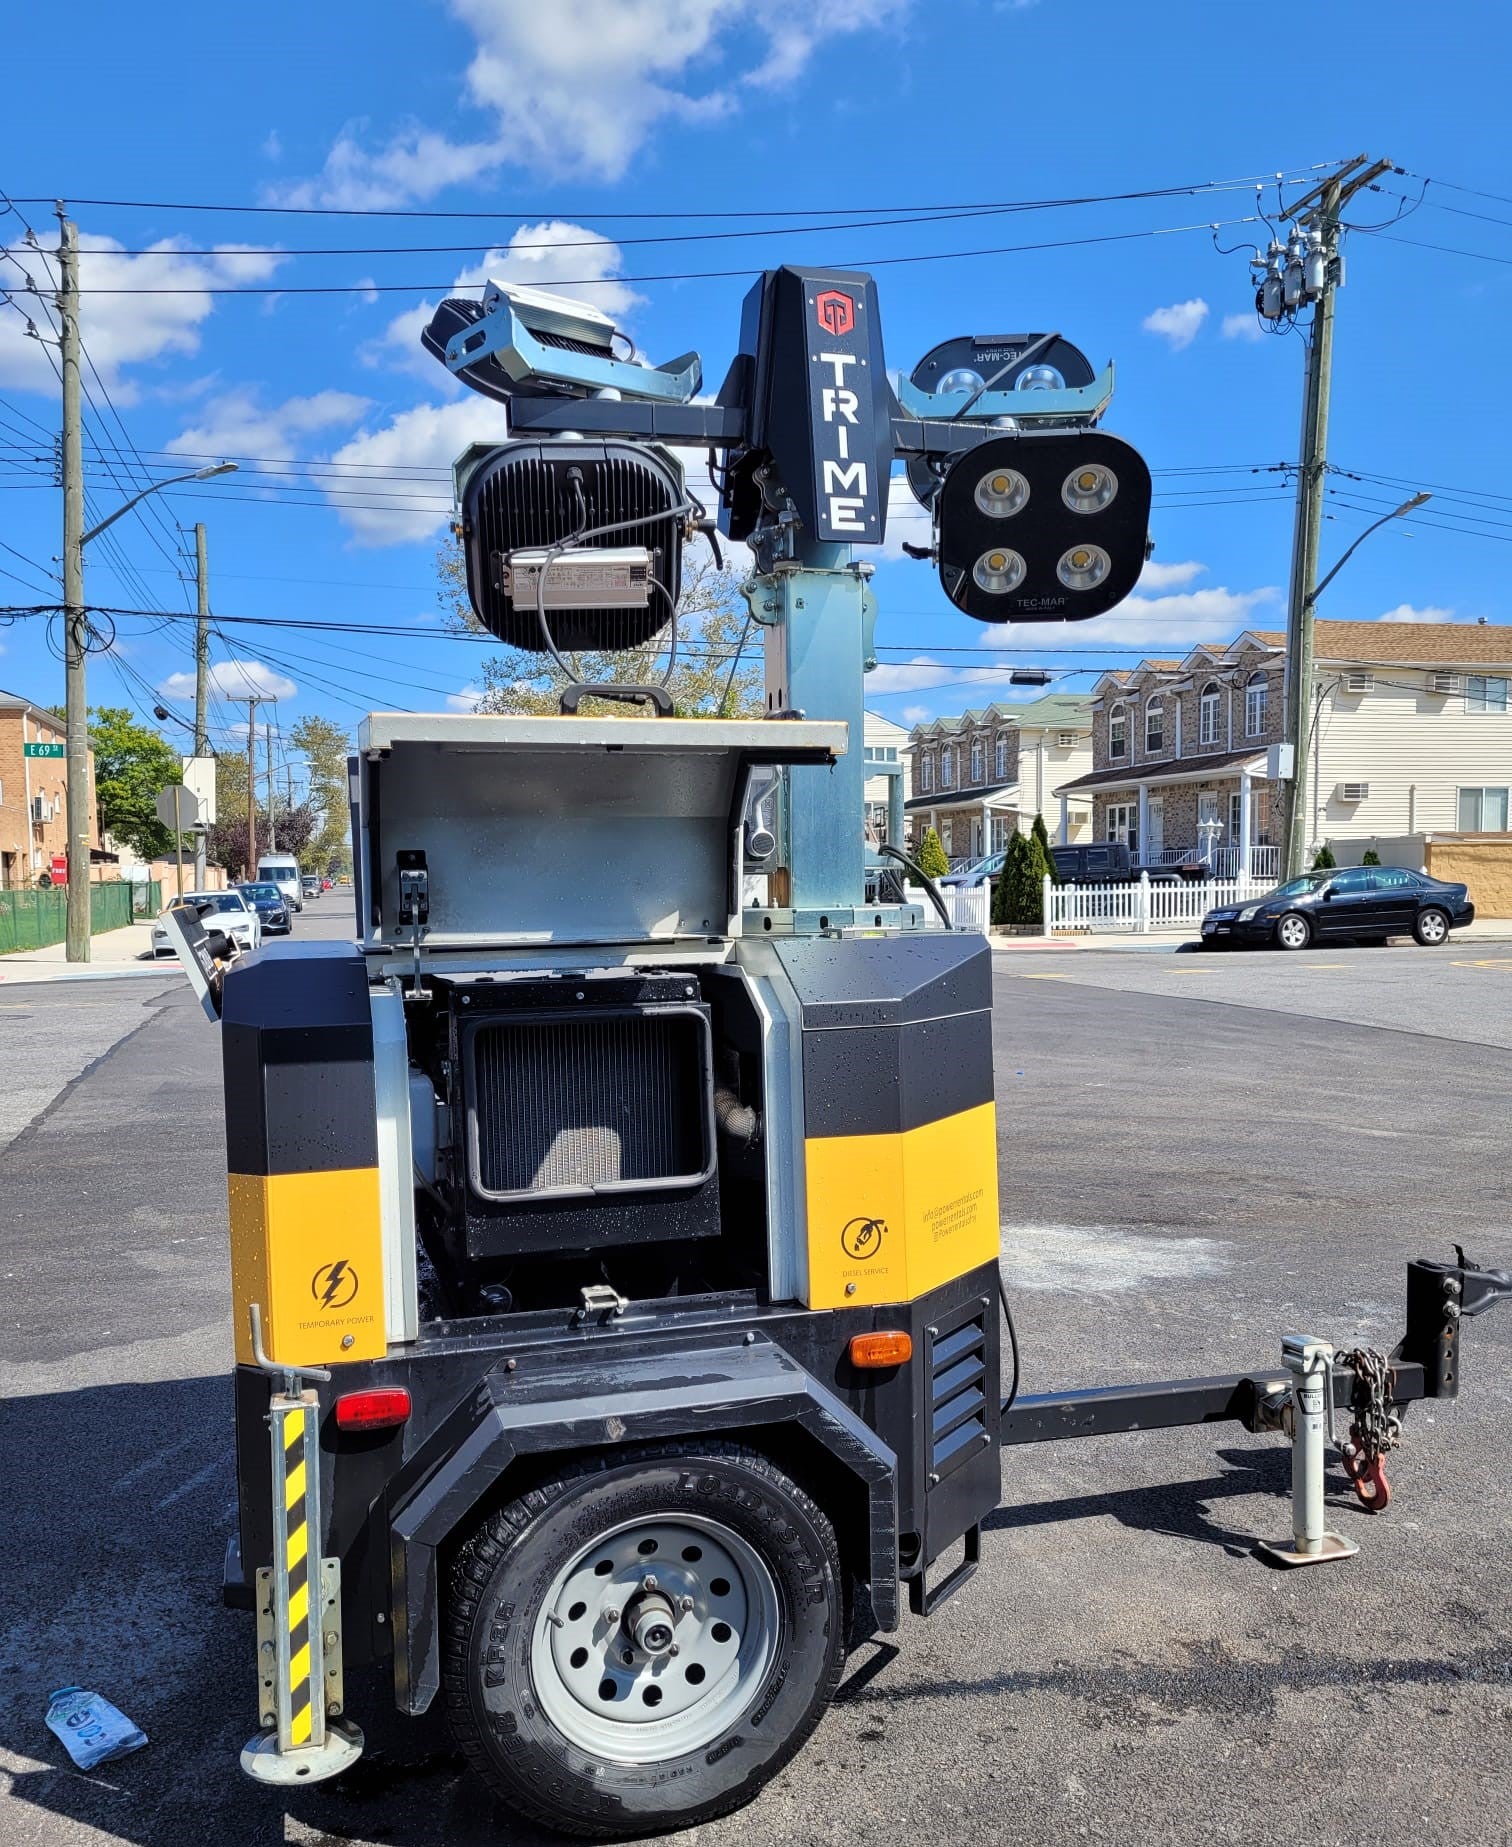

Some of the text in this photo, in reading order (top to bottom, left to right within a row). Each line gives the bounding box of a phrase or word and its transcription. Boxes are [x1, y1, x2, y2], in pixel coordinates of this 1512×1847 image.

[820, 352, 868, 532] TRIME
[1016, 597, 1065, 608] TEC-MAR
[30, 744, 36, 756] E
[38, 745, 50, 756] 69
[842, 1267, 889, 1278] DIESEL SERVICE
[298, 1315, 375, 1330] TEMPORARY POWER
